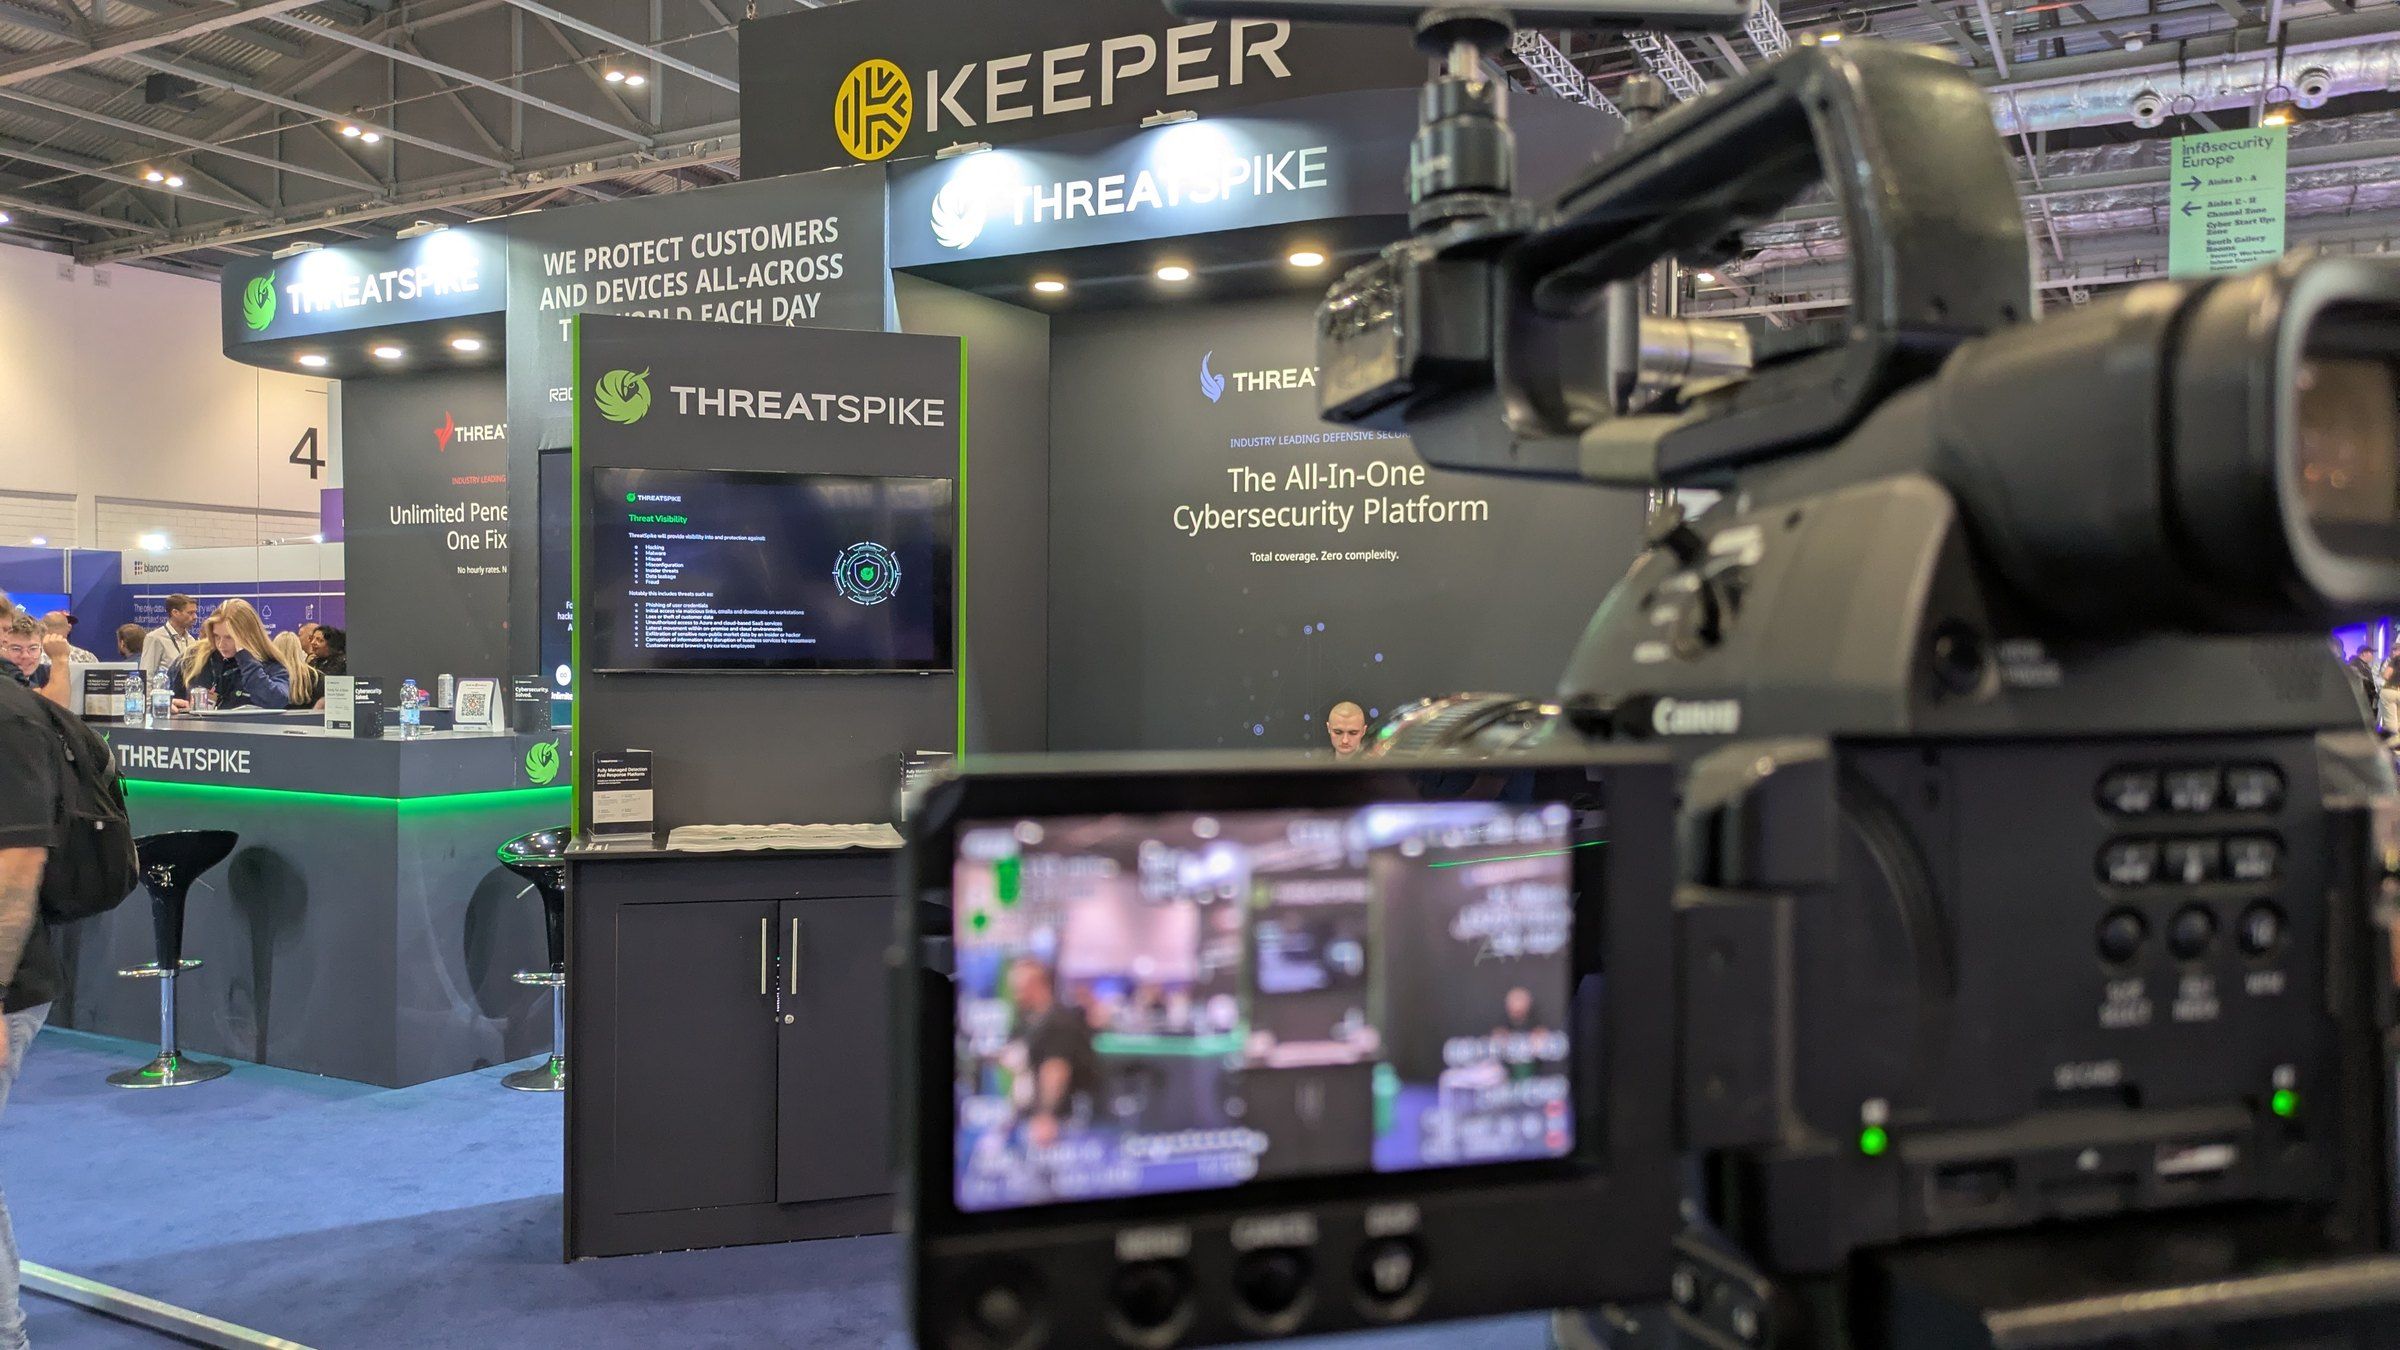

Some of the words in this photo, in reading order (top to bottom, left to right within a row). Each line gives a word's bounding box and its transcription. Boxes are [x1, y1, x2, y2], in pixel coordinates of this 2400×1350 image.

[927, 18, 1292, 133] KEEPER
[2182, 154, 2235, 169] Europe
[1006, 146, 1327, 226] THREATSPIKE
[544, 250, 576, 276] WE
[584, 236, 684, 272] PROTECT
[691, 216, 839, 259] CUSTOMERS
[539, 283, 588, 311] AND
[596, 271, 688, 305] DEVICES
[695, 253, 843, 295] ALL-ACROSS
[701, 298, 762, 325] EACH
[772, 292, 822, 323] DAY
[1232, 366, 1321, 392] THREA
[670, 385, 945, 427] THREATSPIKE
[454, 424, 507, 443] THREA
[1230, 435, 1277, 448] INDUSTRY
[1278, 433, 1321, 446] LEADING
[1323, 430, 1374, 443] DEFENSIVE
[1376, 430, 1411, 440] SECUR
[289, 427, 326, 480] 4
[451, 475, 480, 485] INDUSTRY
[1227, 465, 1277, 493] The
[1285, 460, 1426, 491] All-In-One
[637, 494, 682, 502] THREATSPIKE
[390, 502, 465, 525] Unlimited
[628, 514, 654, 523] Threat
[655, 515, 688, 525] Visibility
[1173, 499, 1355, 537] Cybersecurity
[1363, 494, 1489, 525] Platform
[446, 531, 480, 550] One
[485, 529, 508, 550] Fix
[143, 562, 170, 573] blancco
[1250, 550, 1272, 562] Total
[1274, 551, 1319, 564] coverage.
[1321, 550, 1343, 561] Zero
[1344, 548, 1400, 563] complexity.
[457, 566, 466, 574] No
[467, 566, 485, 576] hourly
[117, 744, 251, 774] THREATSPIKE
